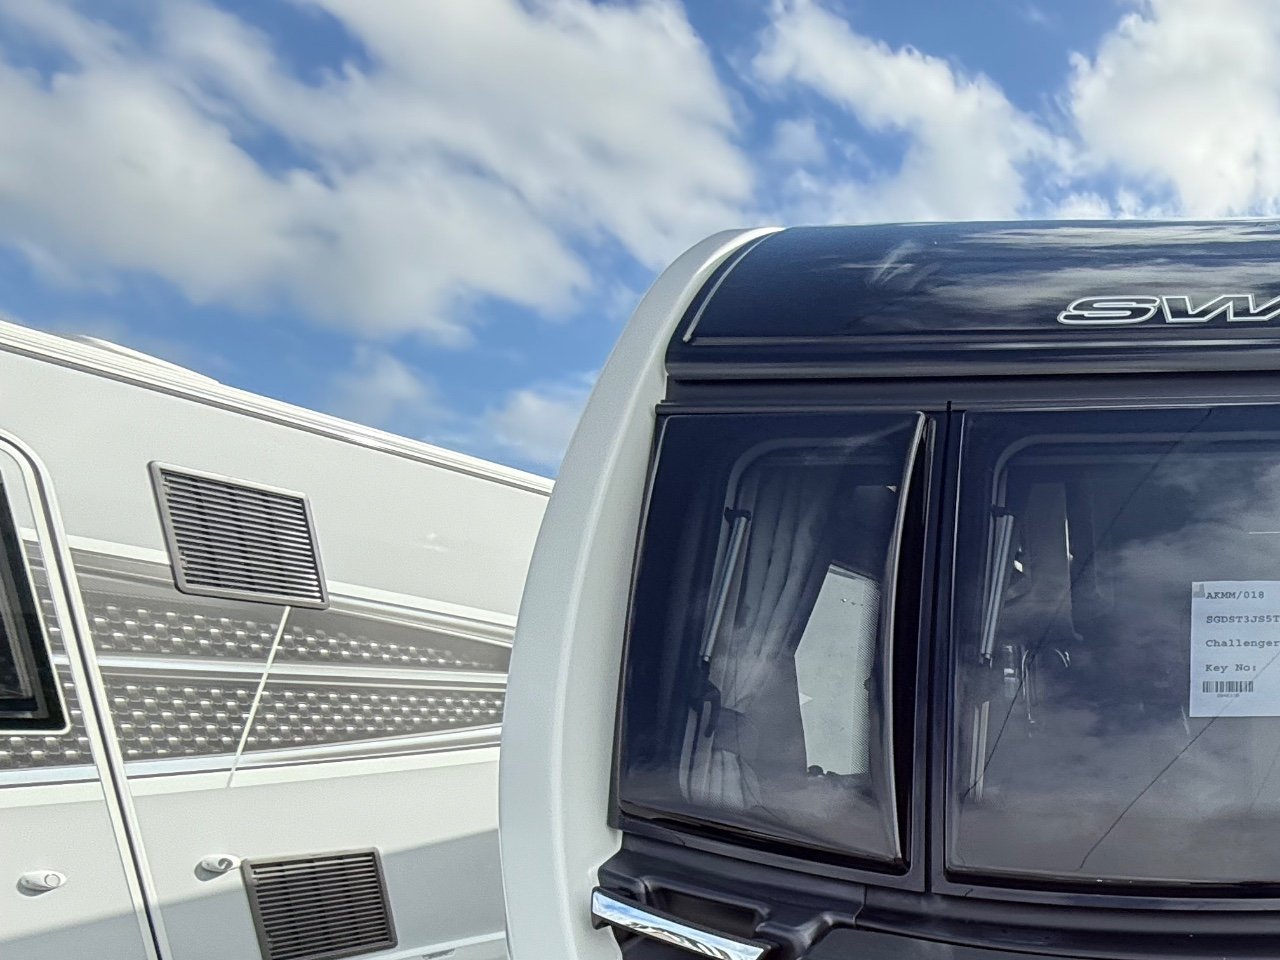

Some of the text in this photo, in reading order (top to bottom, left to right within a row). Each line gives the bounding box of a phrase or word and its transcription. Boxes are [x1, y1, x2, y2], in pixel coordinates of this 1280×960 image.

[1206, 591, 1265, 600] AKMM/018
[1205, 639, 1280, 649] Challenger
[1205, 663, 1257, 674] Key No:
